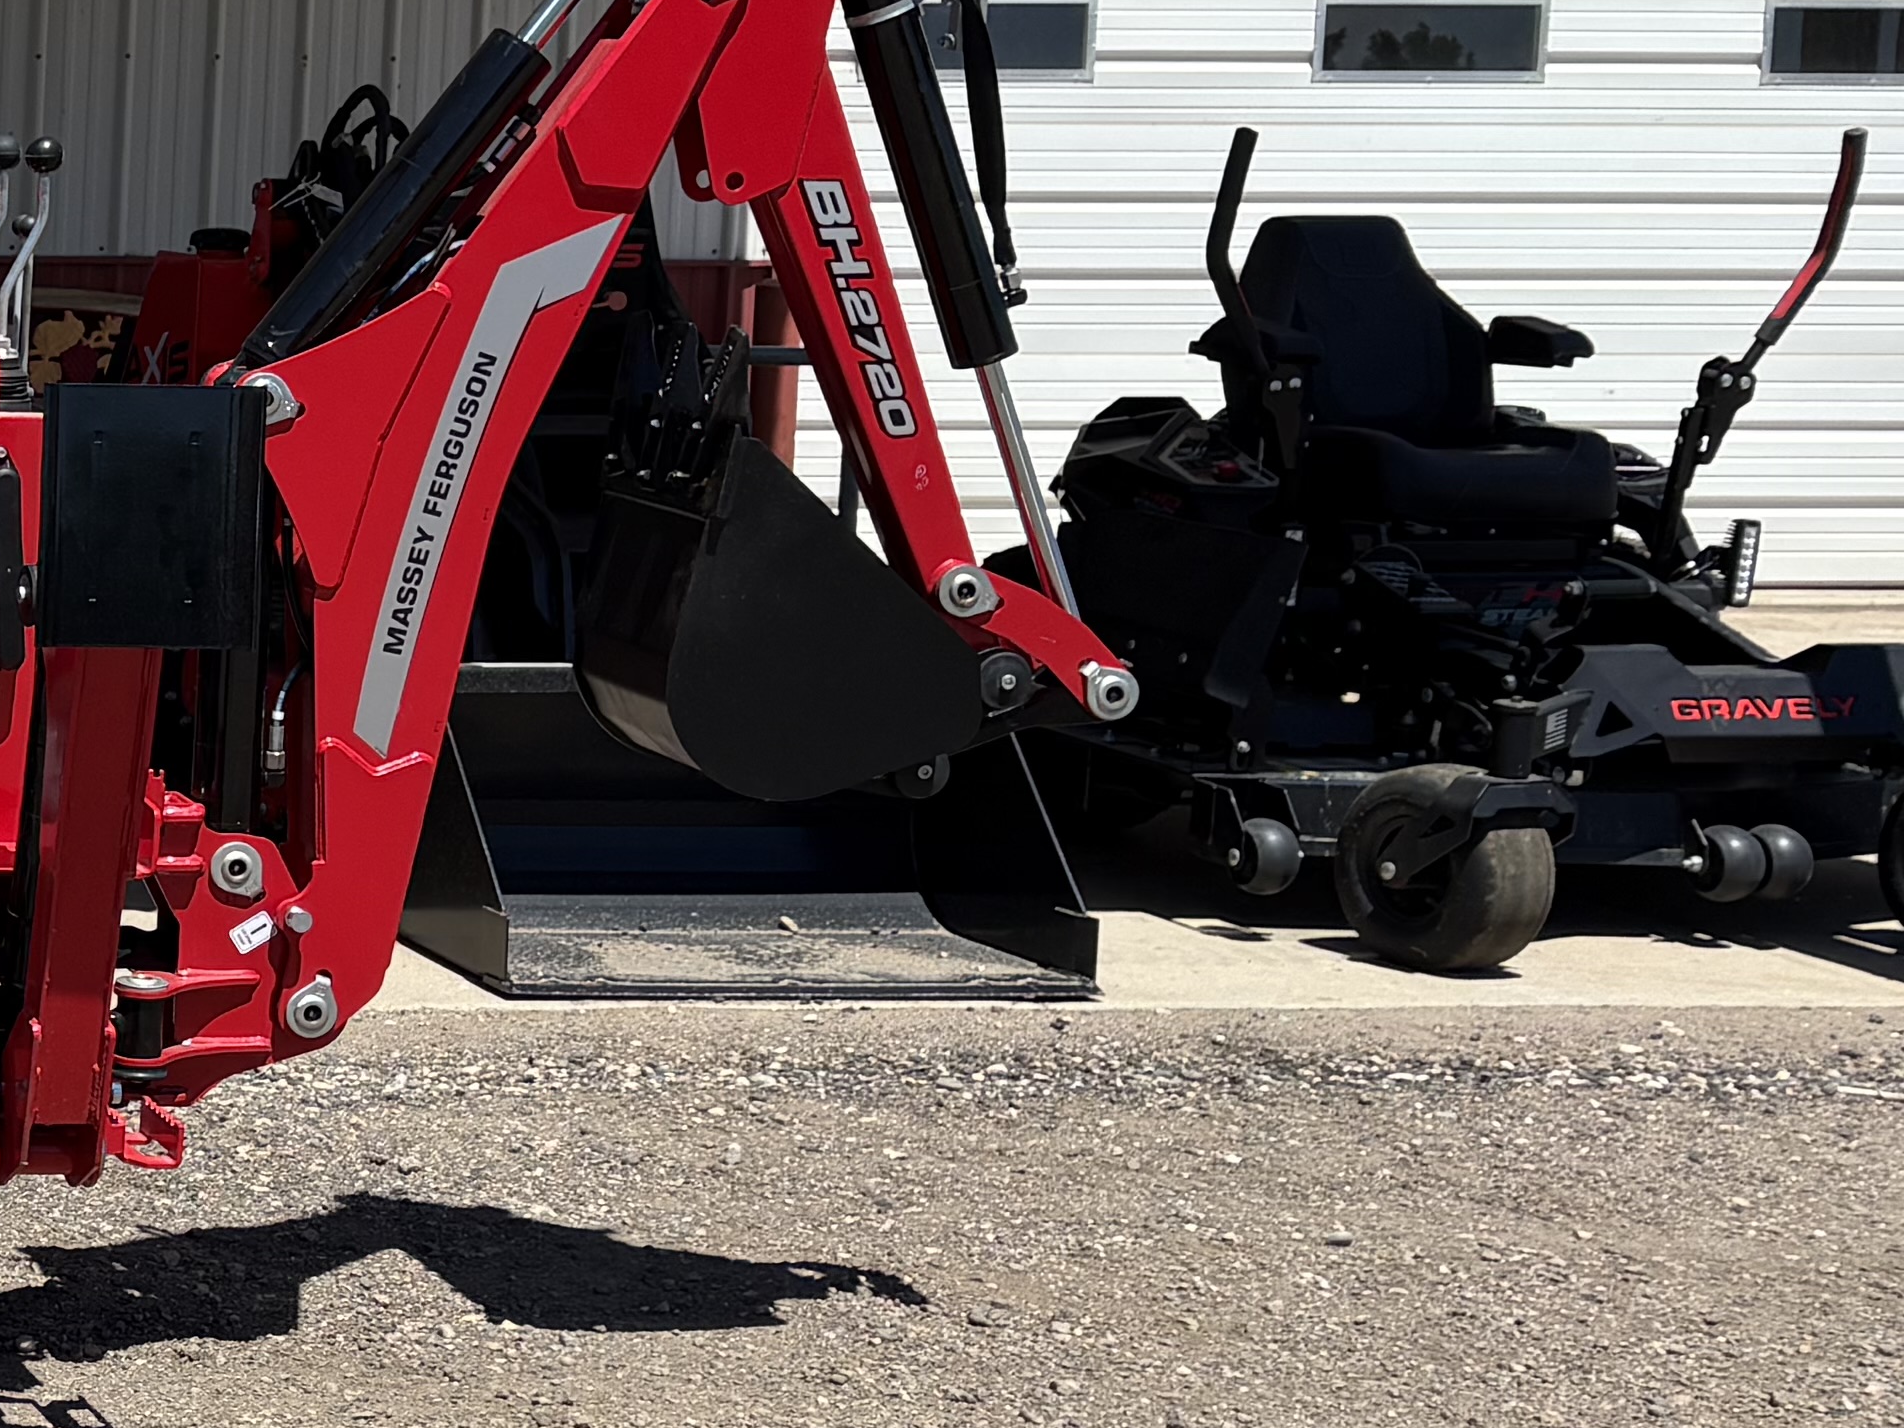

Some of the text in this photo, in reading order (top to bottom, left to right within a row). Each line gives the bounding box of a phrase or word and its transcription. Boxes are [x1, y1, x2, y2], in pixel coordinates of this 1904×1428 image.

[803, 180, 916, 436] BH.2720
[382, 351, 498, 655] MASSEY FERGUSON
[1670, 697, 1854, 721] GRAVELY
